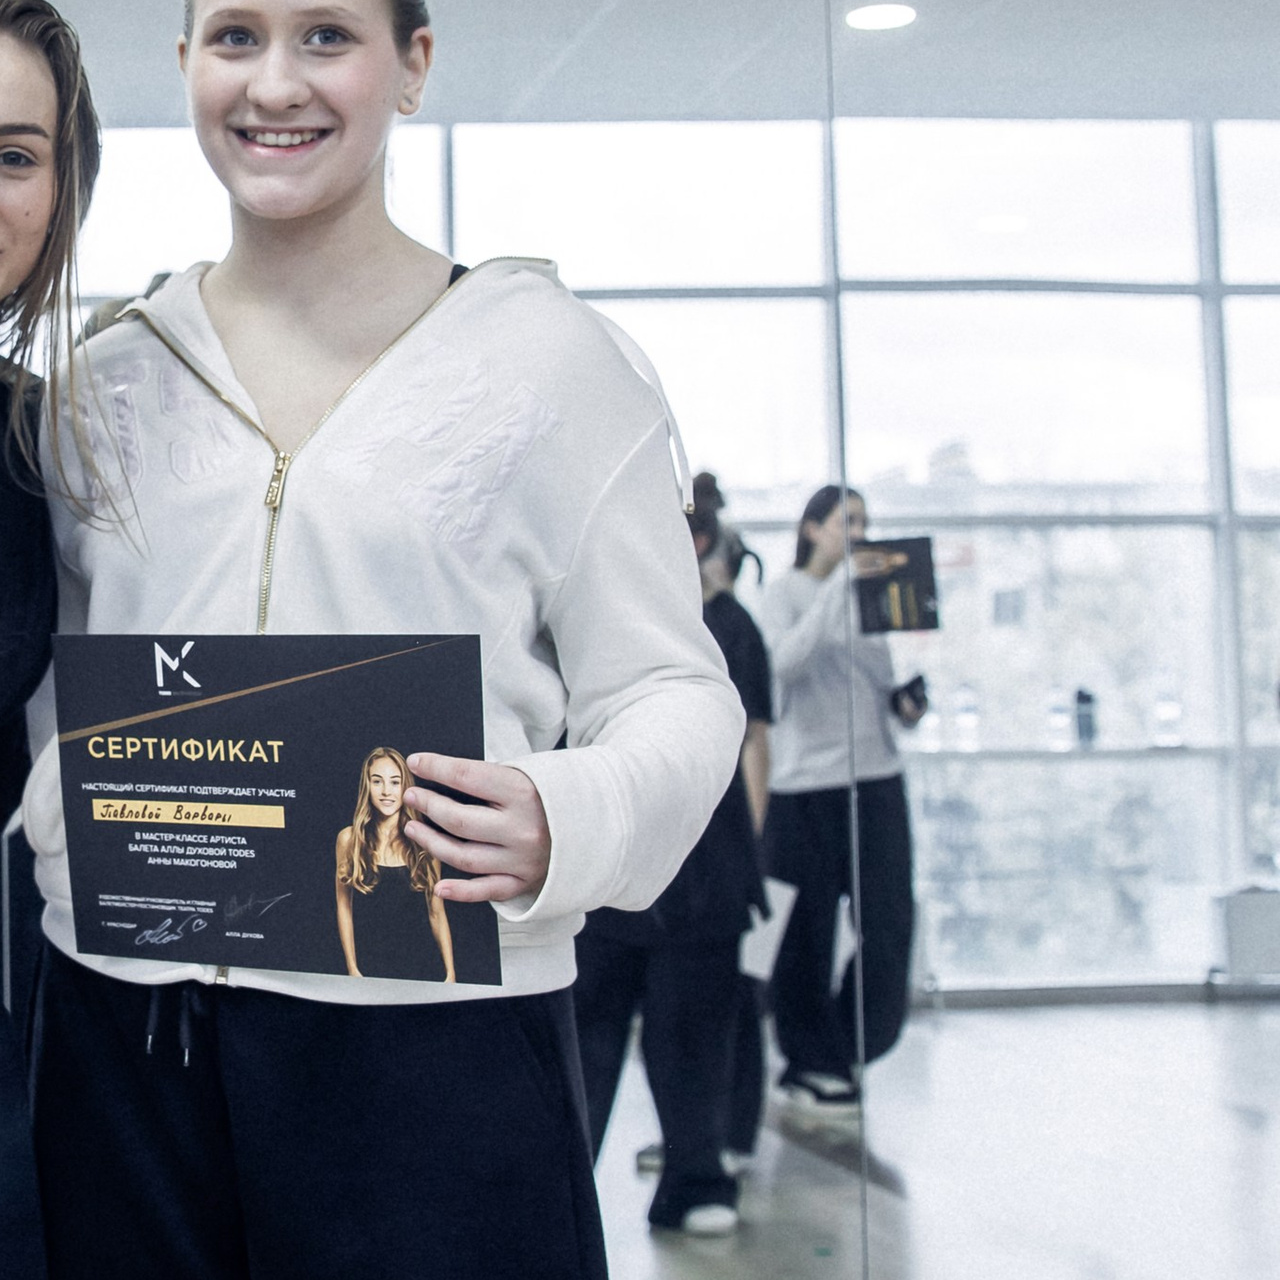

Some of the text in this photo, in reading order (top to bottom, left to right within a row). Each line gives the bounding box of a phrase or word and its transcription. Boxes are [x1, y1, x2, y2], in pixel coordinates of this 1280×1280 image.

[87, 736, 284, 762] СЕРТИФИКАТ
[82, 783, 296, 798] НАСТОЯЩИЙ СЕРТИФИКАТ ПОДТВЕРЖДАЕТ УЧАСТИЕ
[173, 805, 233, 822] Варвары
[135, 832, 247, 845] В МАСТЕР-КЛАССЕ АРТИСТА
[128, 844, 256, 858] БАЛЕТА АЛЛЫ ДУХОВОЙ TODES
[148, 856, 237, 869] АННЫ МАКОГОНОВОЙ
